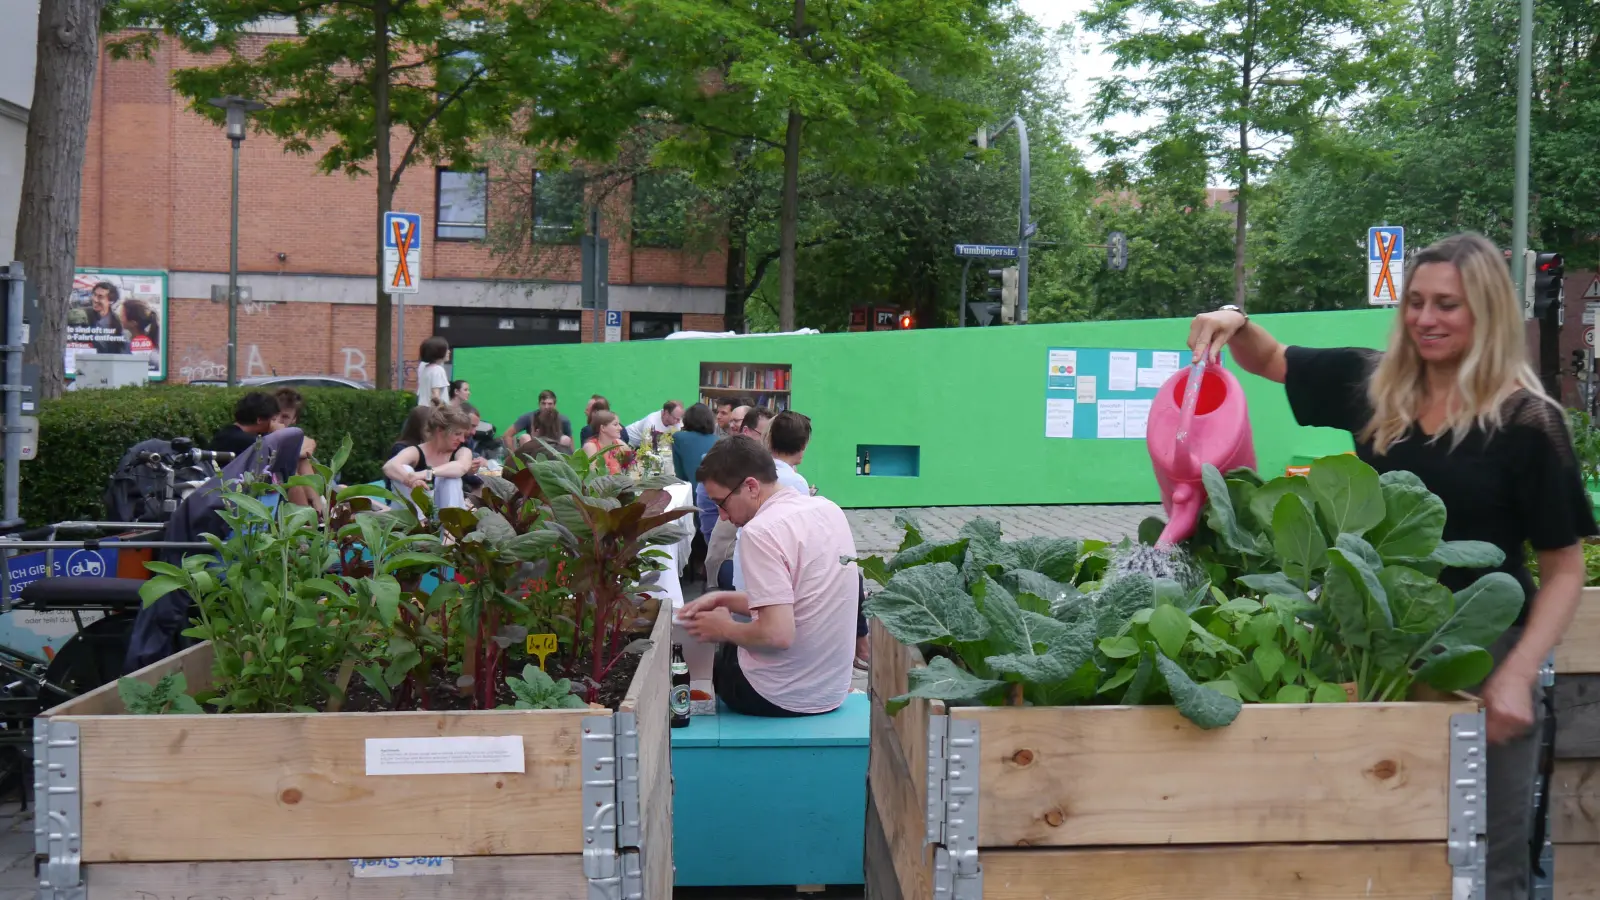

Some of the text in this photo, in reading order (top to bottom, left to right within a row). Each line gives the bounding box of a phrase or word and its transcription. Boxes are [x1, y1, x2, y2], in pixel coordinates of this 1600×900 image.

[390, 217, 409, 244] P
[959, 245, 1016, 257] Tumblingerstr.
[607, 312, 617, 325] P
[247, 344, 268, 377] A
[8, 561, 61, 580] ICH GIBS
